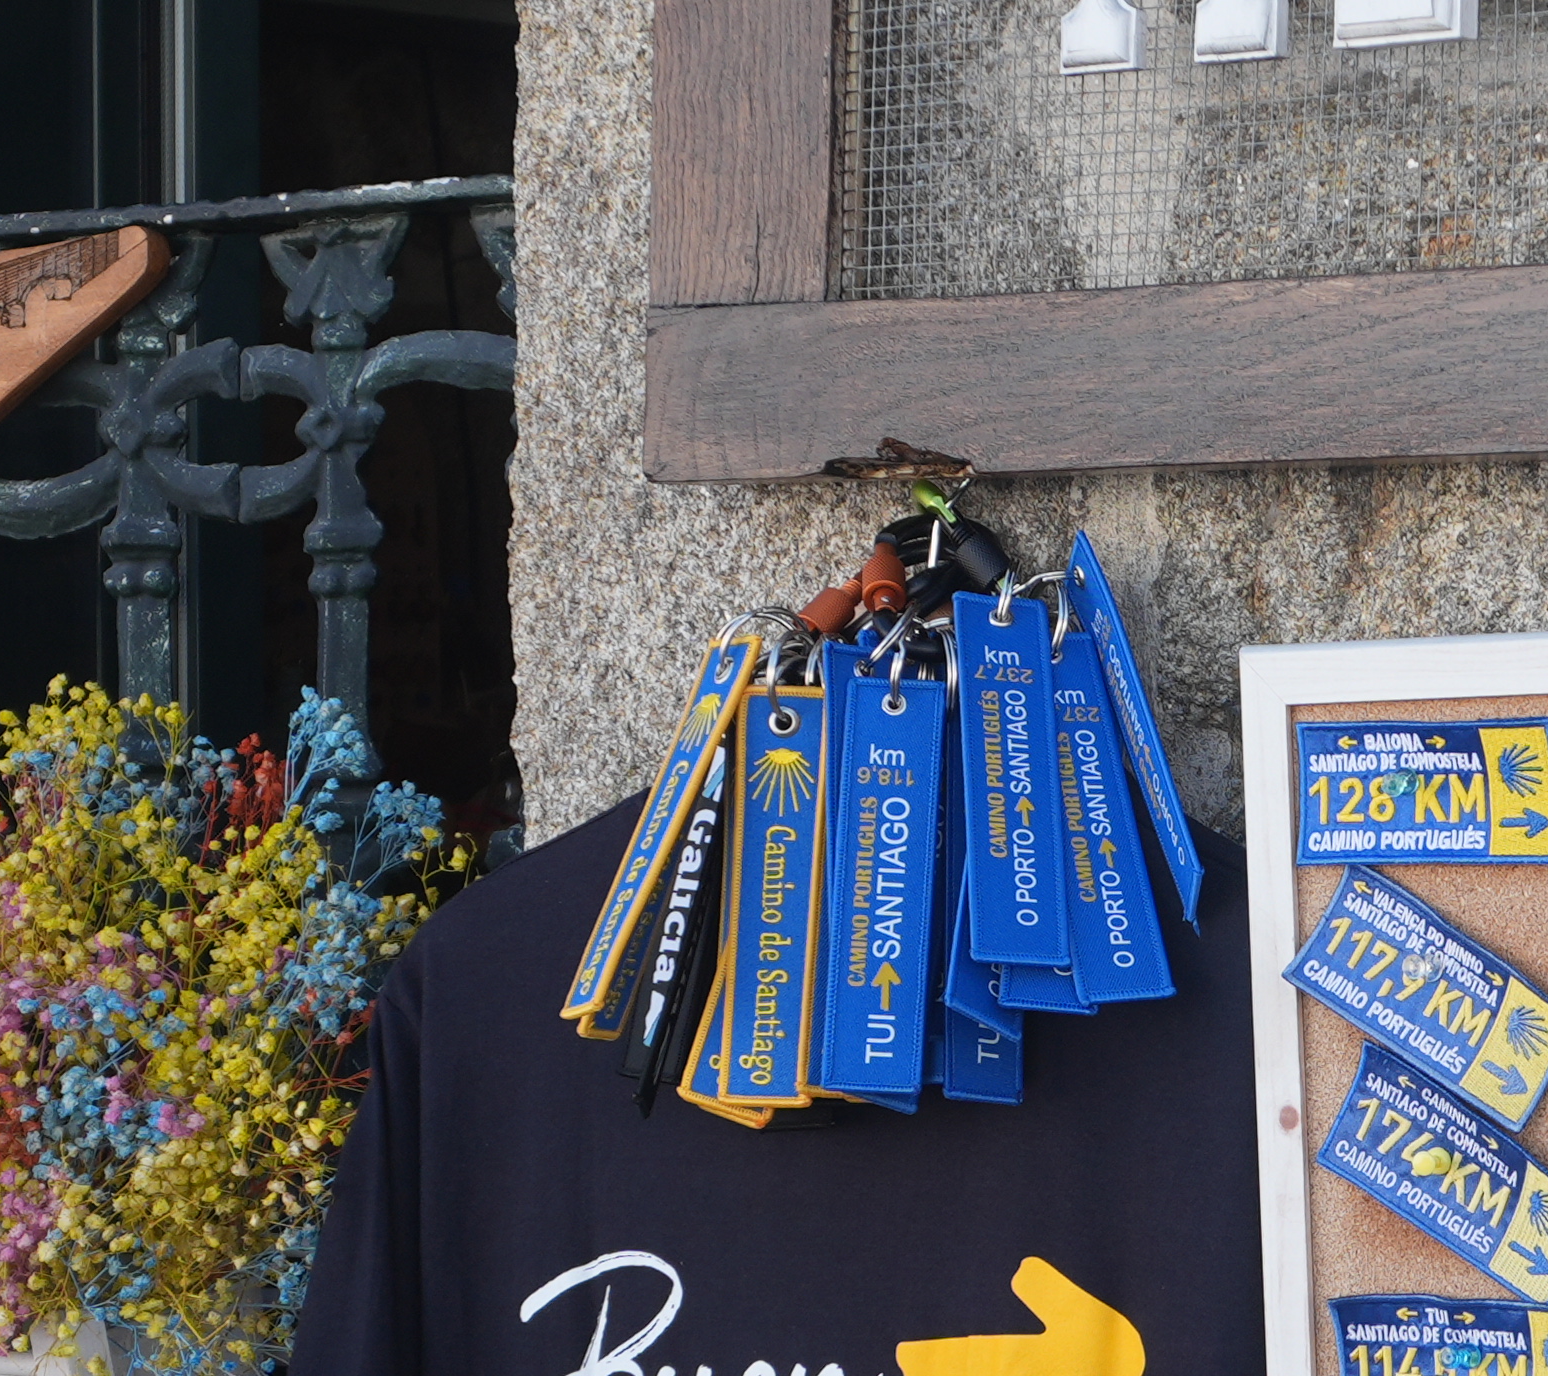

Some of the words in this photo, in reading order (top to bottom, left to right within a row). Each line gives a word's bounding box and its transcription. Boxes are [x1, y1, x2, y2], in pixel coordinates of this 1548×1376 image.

[984, 644, 1019, 666] km
[869, 744, 905, 766] km
[1005, 689, 1034, 796] SANTIAGO
[1364, 733, 1424, 752] BAIONA
[640, 759, 690, 850] Camino
[1309, 775, 1396, 824] 128
[1414, 774, 1486, 823] KM
[629, 855, 648, 884] de
[761, 825, 796, 923] Camino
[1014, 828, 1039, 904] PORTO
[1309, 831, 1376, 852] CAMINO
[1381, 825, 1486, 851] PORTUGUÉS
[653, 808, 717, 984] Galicia
[872, 797, 911, 960] SANTIAGO
[579, 888, 634, 996] Santiago
[759, 931, 792, 962] de
[847, 914, 870, 987] CAMINO
[1372, 888, 1426, 933] VALENÇA
[1425, 925, 1445, 946] DO
[1443, 937, 1484, 974] MINHO
[739, 969, 788, 1086] Santiago
[865, 1014, 896, 1064] TUI
[1303, 959, 1369, 1010] CAMINO
[1366, 1000, 1467, 1075] PORTUGUÉS
[1423, 979, 1492, 1048] KM
[1421, 1087, 1478, 1134] CAMINHA
[1426, 1307, 1450, 1326] TUI
